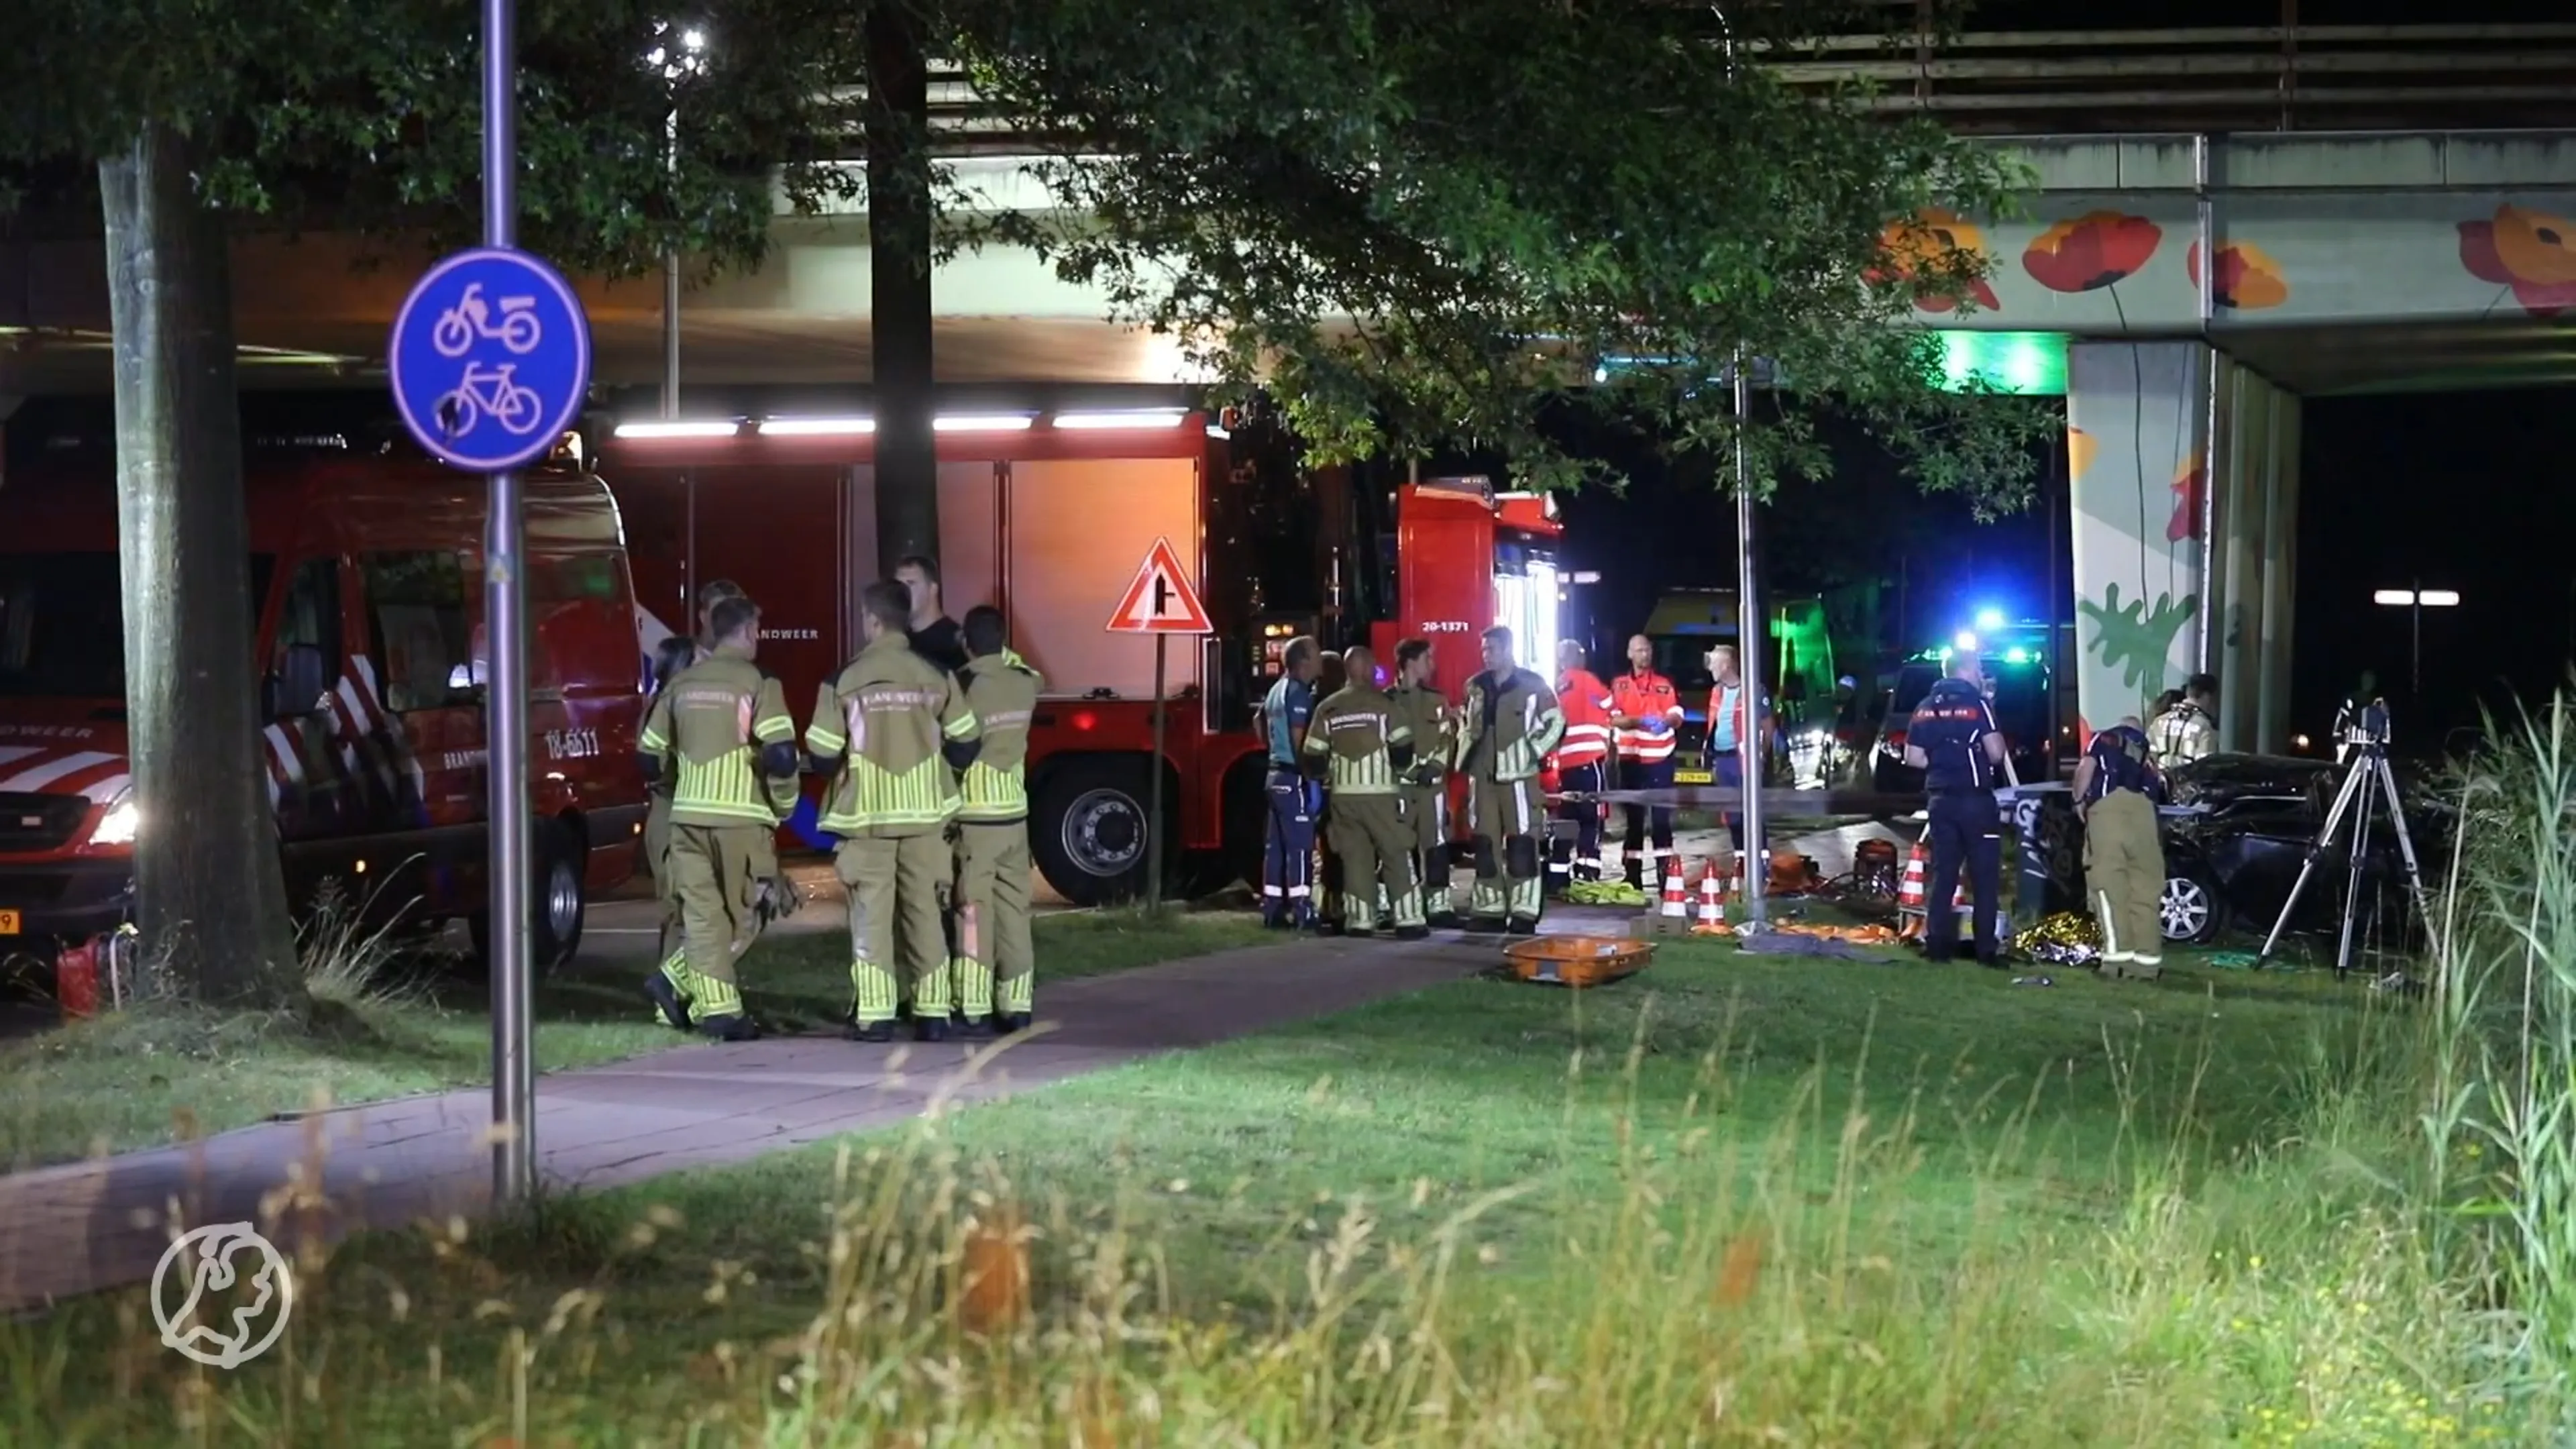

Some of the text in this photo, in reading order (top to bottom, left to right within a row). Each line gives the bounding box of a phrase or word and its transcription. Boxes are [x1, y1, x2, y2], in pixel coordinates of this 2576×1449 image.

[1422, 621, 1468, 632] 20-1371
[756, 629, 819, 639] NDWEER
[545, 727, 599, 760] 18-6611
